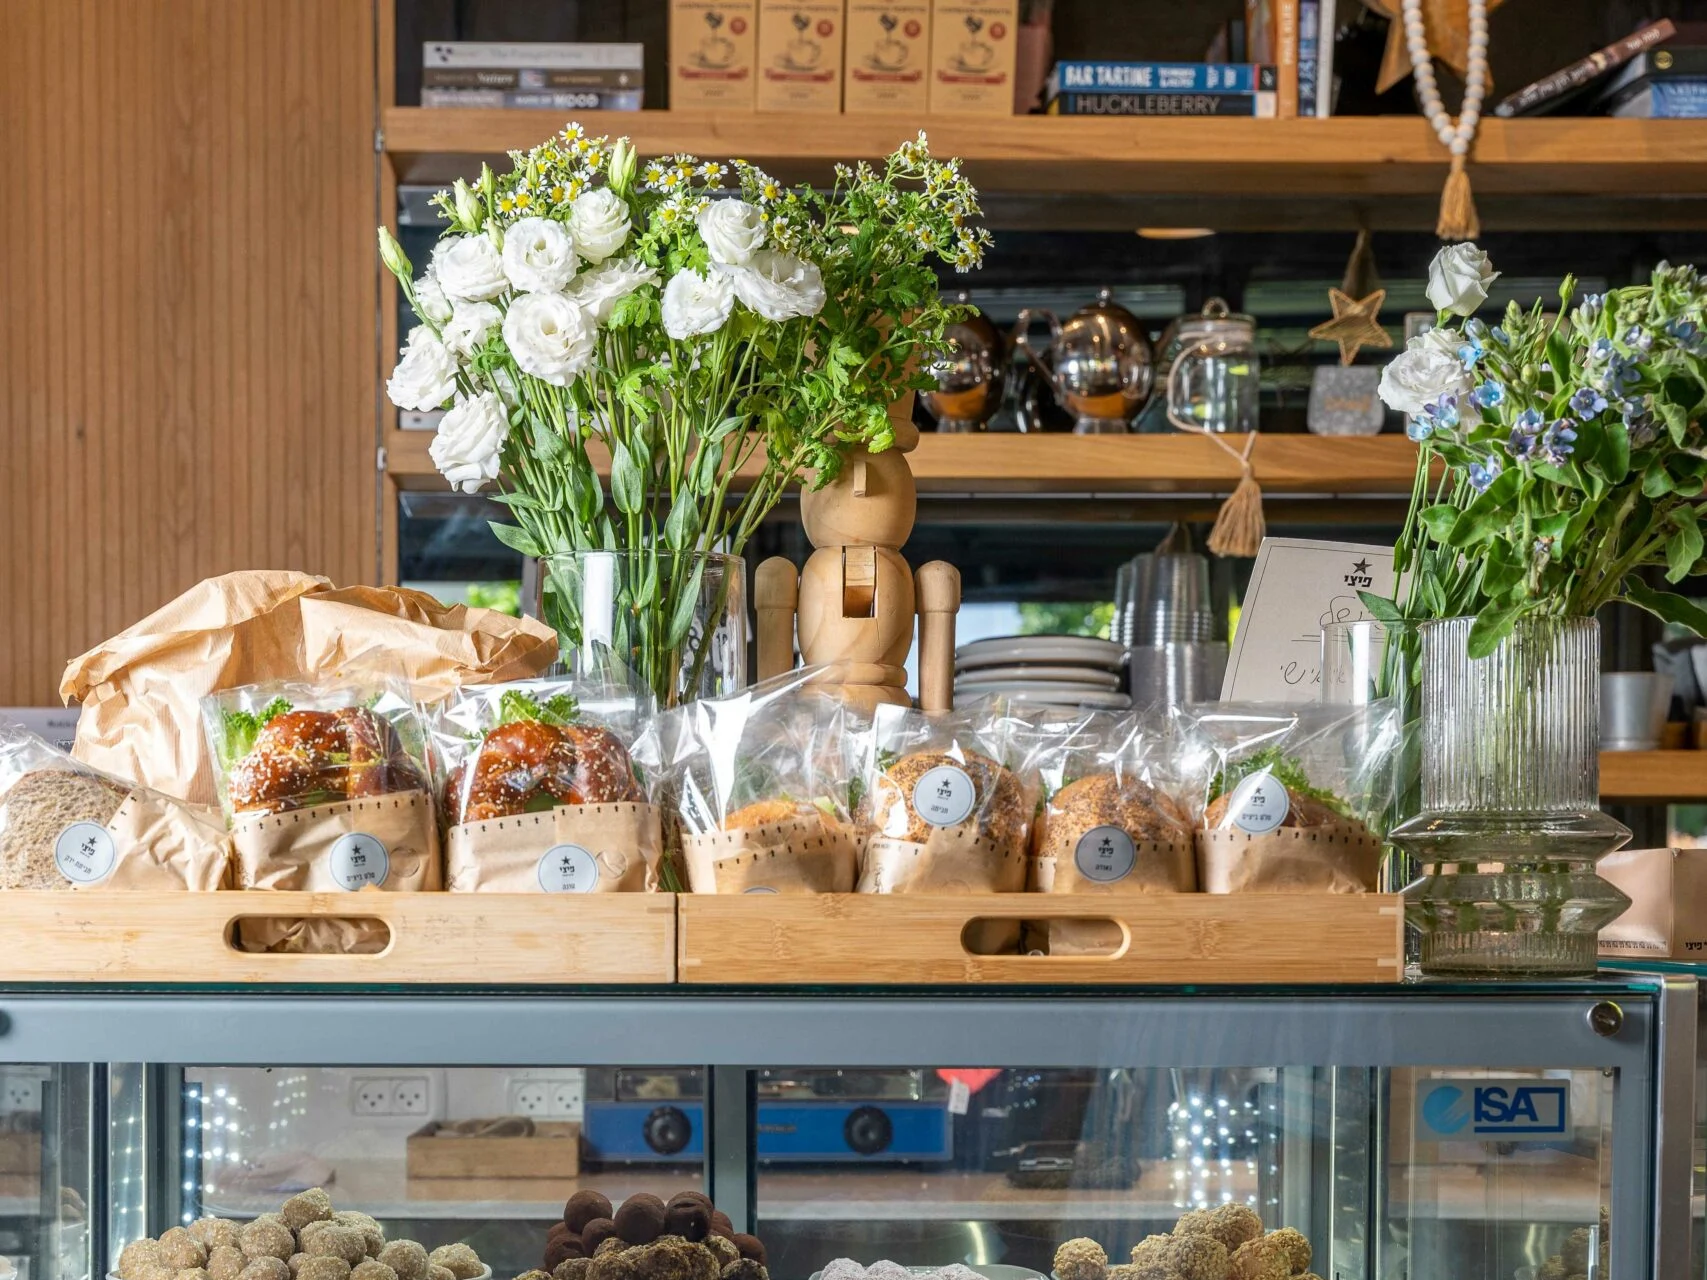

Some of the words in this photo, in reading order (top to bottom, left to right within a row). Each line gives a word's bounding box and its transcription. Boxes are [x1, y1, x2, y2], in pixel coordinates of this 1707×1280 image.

[1077, 95, 1220, 114] HUCKLEBERRY
[1344, 575, 1373, 588] פיצי
[1474, 1086, 1539, 1123] ISA
